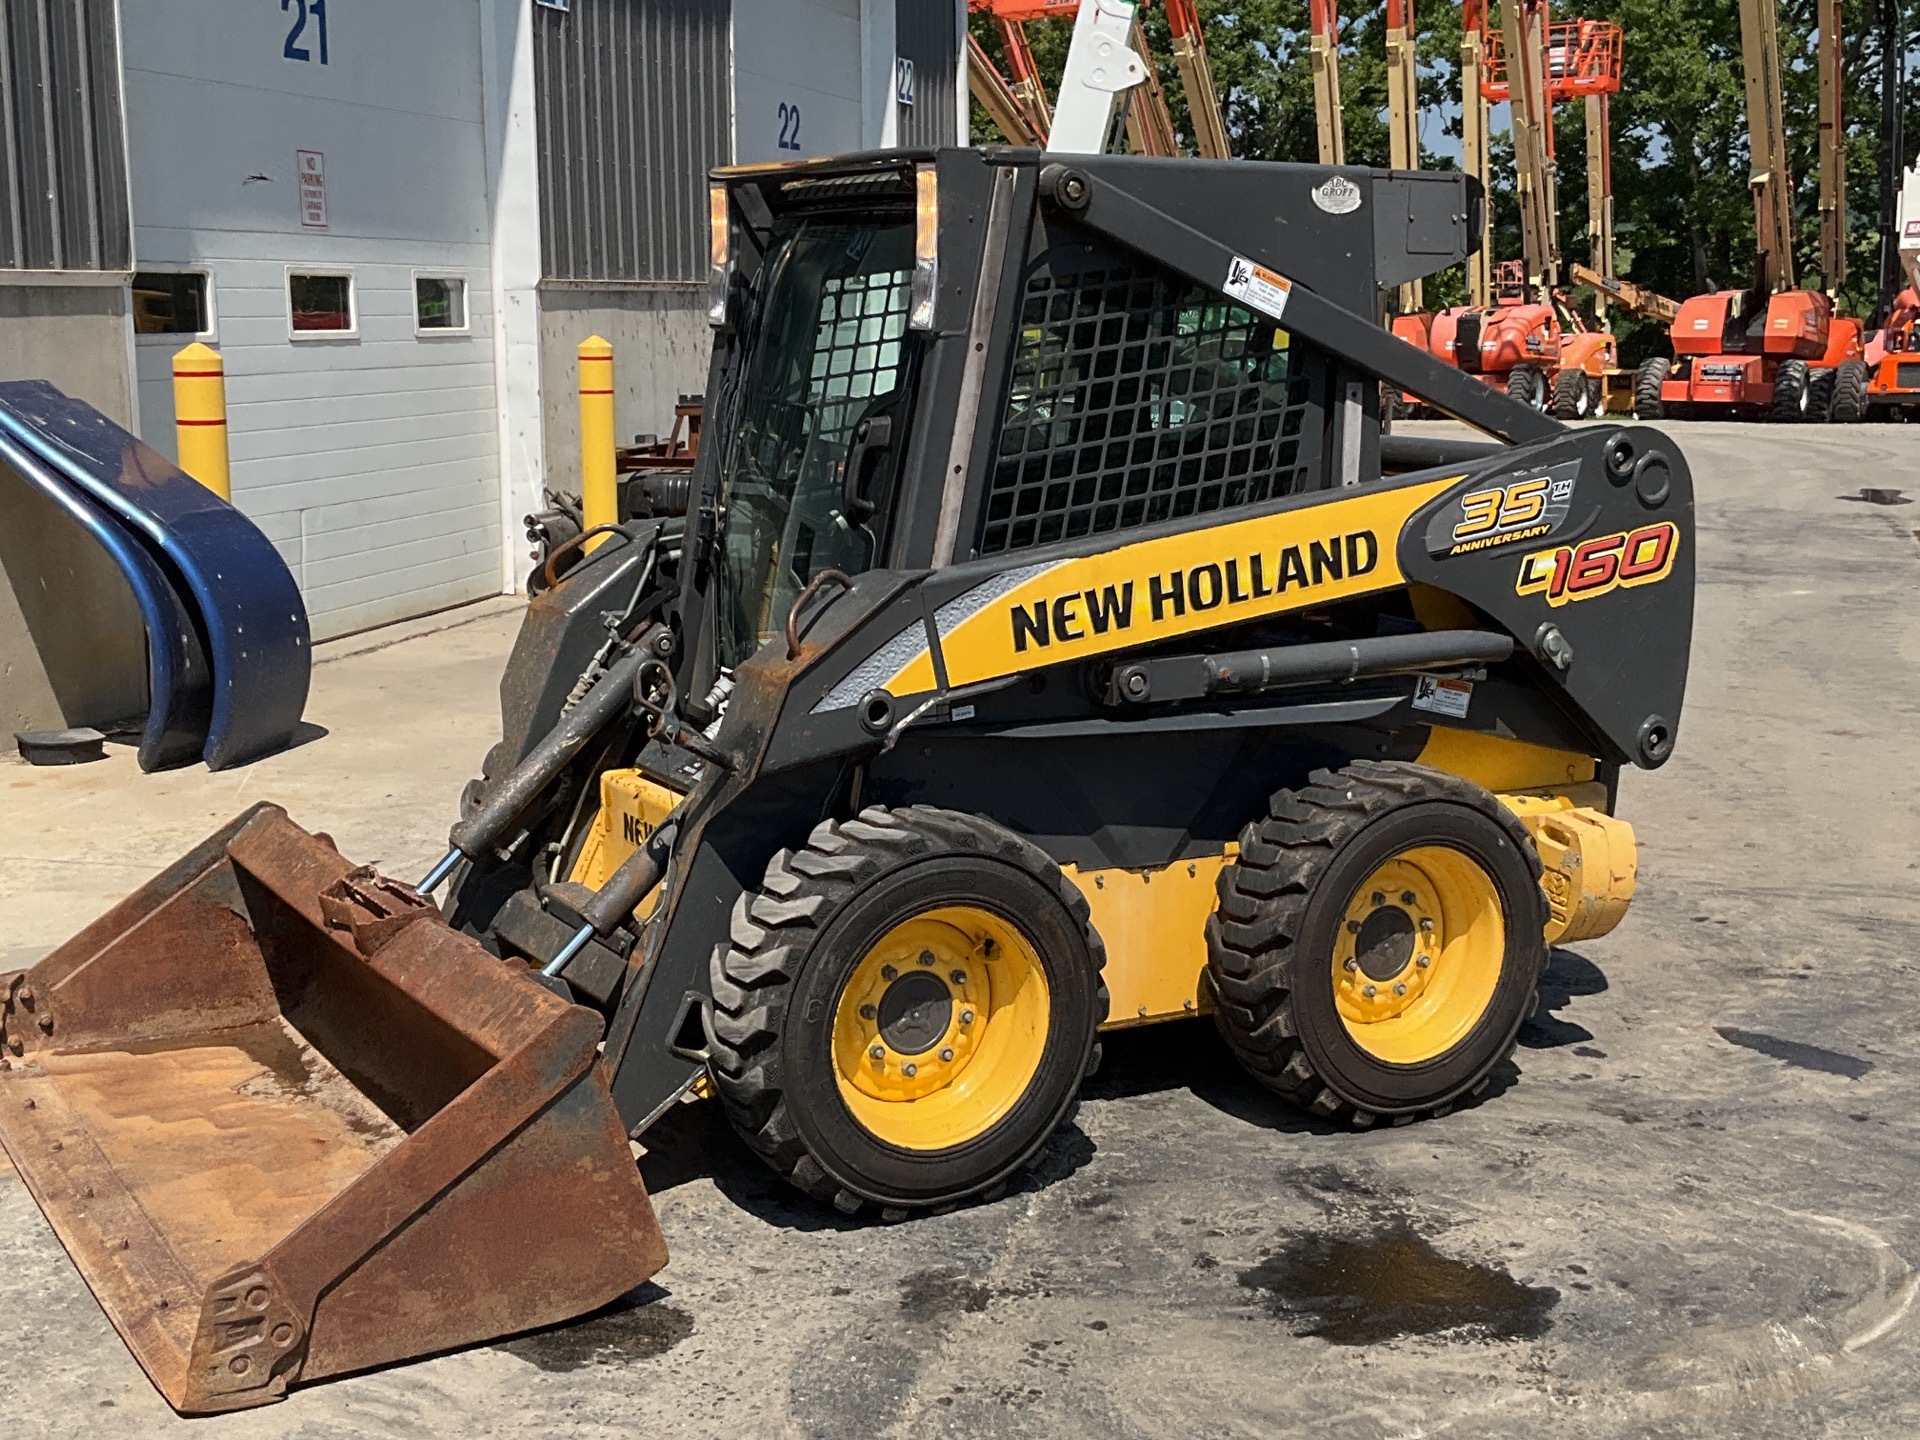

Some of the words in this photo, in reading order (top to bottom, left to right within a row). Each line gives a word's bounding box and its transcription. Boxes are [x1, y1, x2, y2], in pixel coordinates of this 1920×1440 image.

[281, 0, 328, 65] 21
[898, 60, 913, 101] 22
[778, 102, 800, 150] 22
[1322, 187, 1354, 197] GROFF
[1450, 524, 1551, 555] ANNIVERSARY
[1517, 522, 1678, 604] L160
[1010, 579, 1134, 653] NEW
[1148, 529, 1379, 623] HOLLAND
